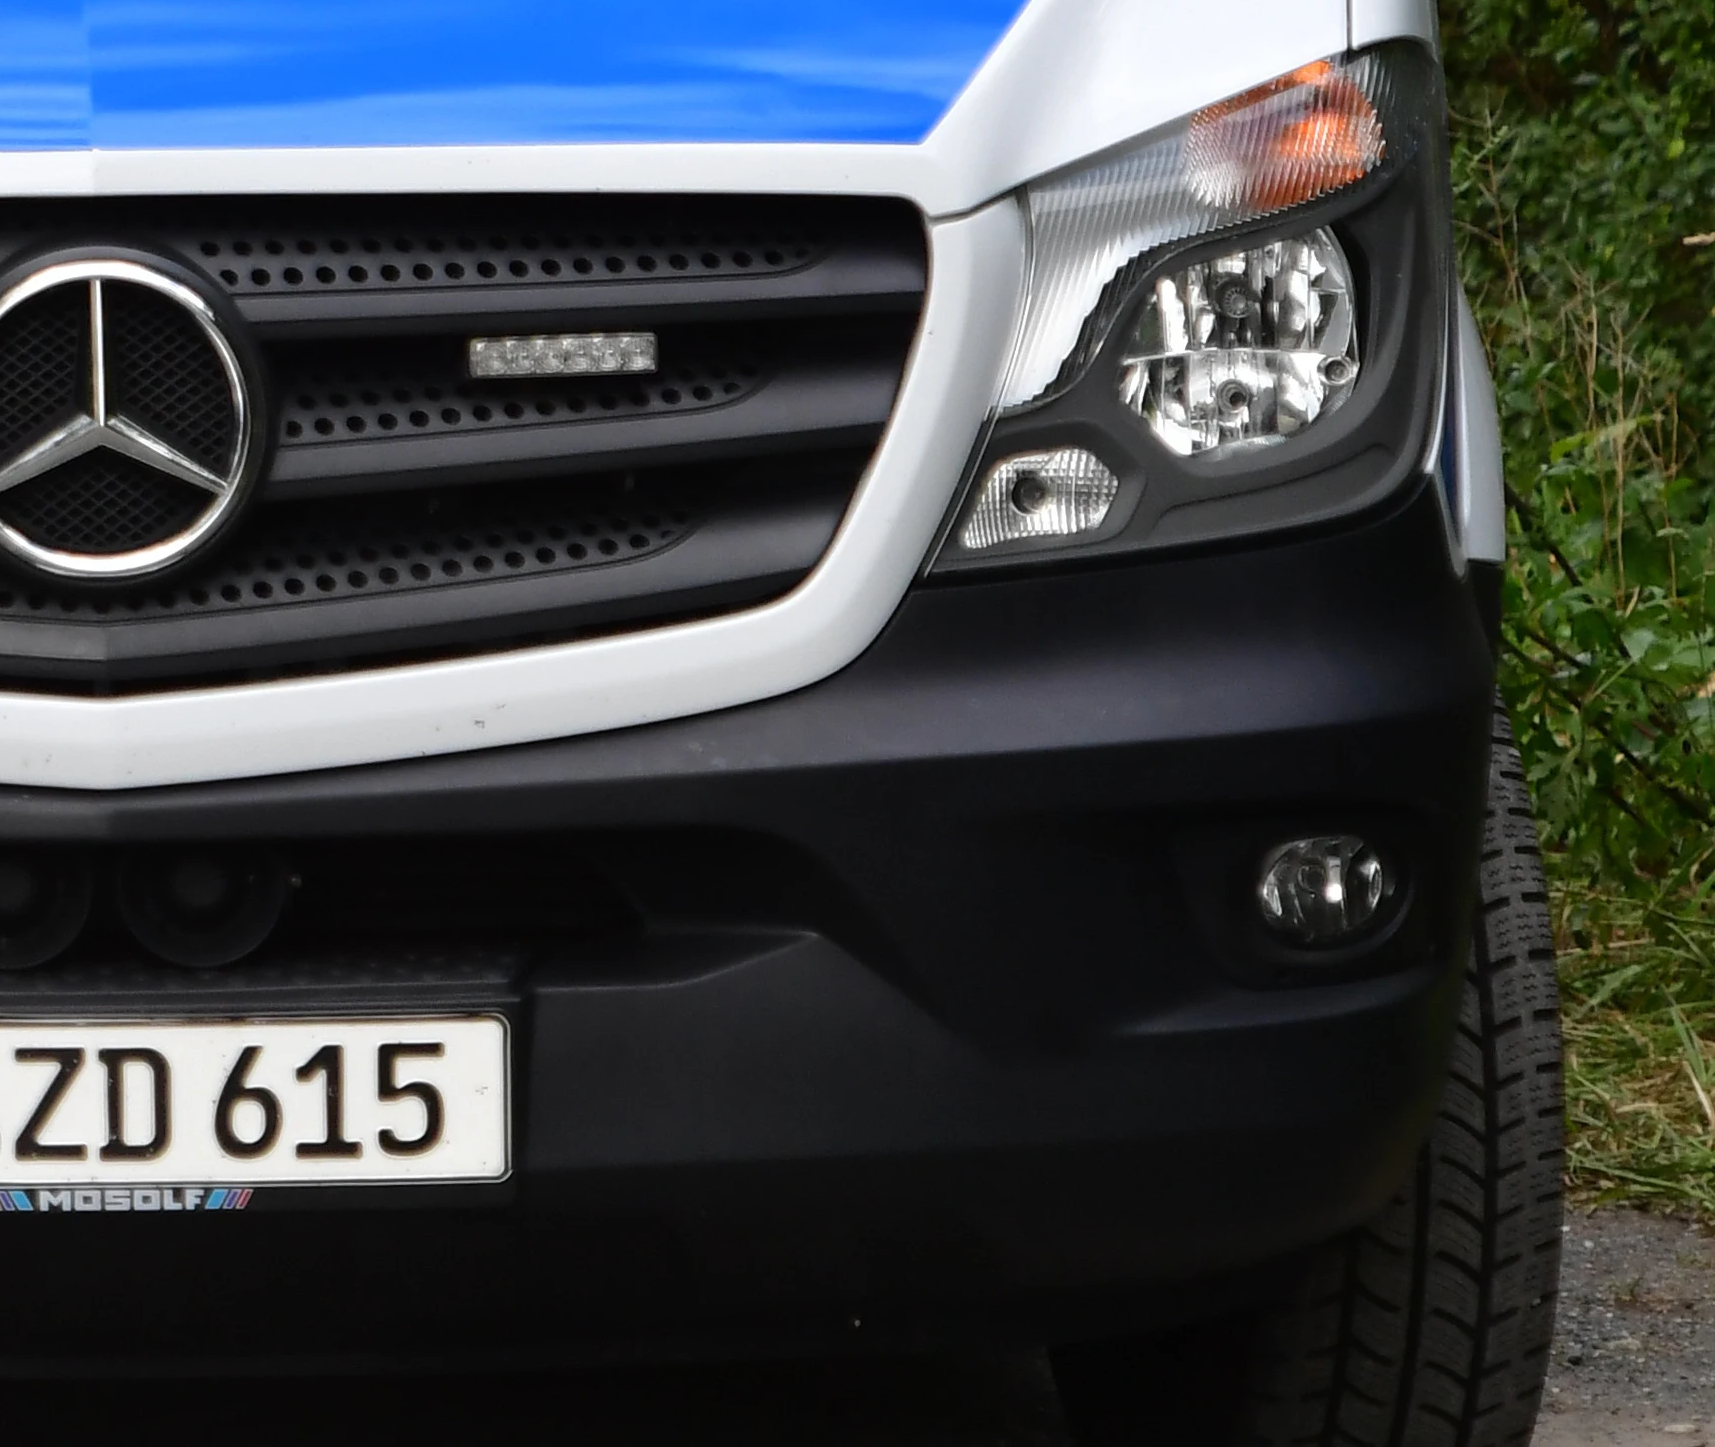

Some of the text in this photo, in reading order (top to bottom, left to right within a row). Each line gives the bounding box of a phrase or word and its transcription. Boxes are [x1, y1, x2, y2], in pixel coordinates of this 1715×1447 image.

[14, 1046, 172, 1161] ZD
[213, 1042, 445, 1158] 615
[38, 1188, 205, 1213] MOSOLF
